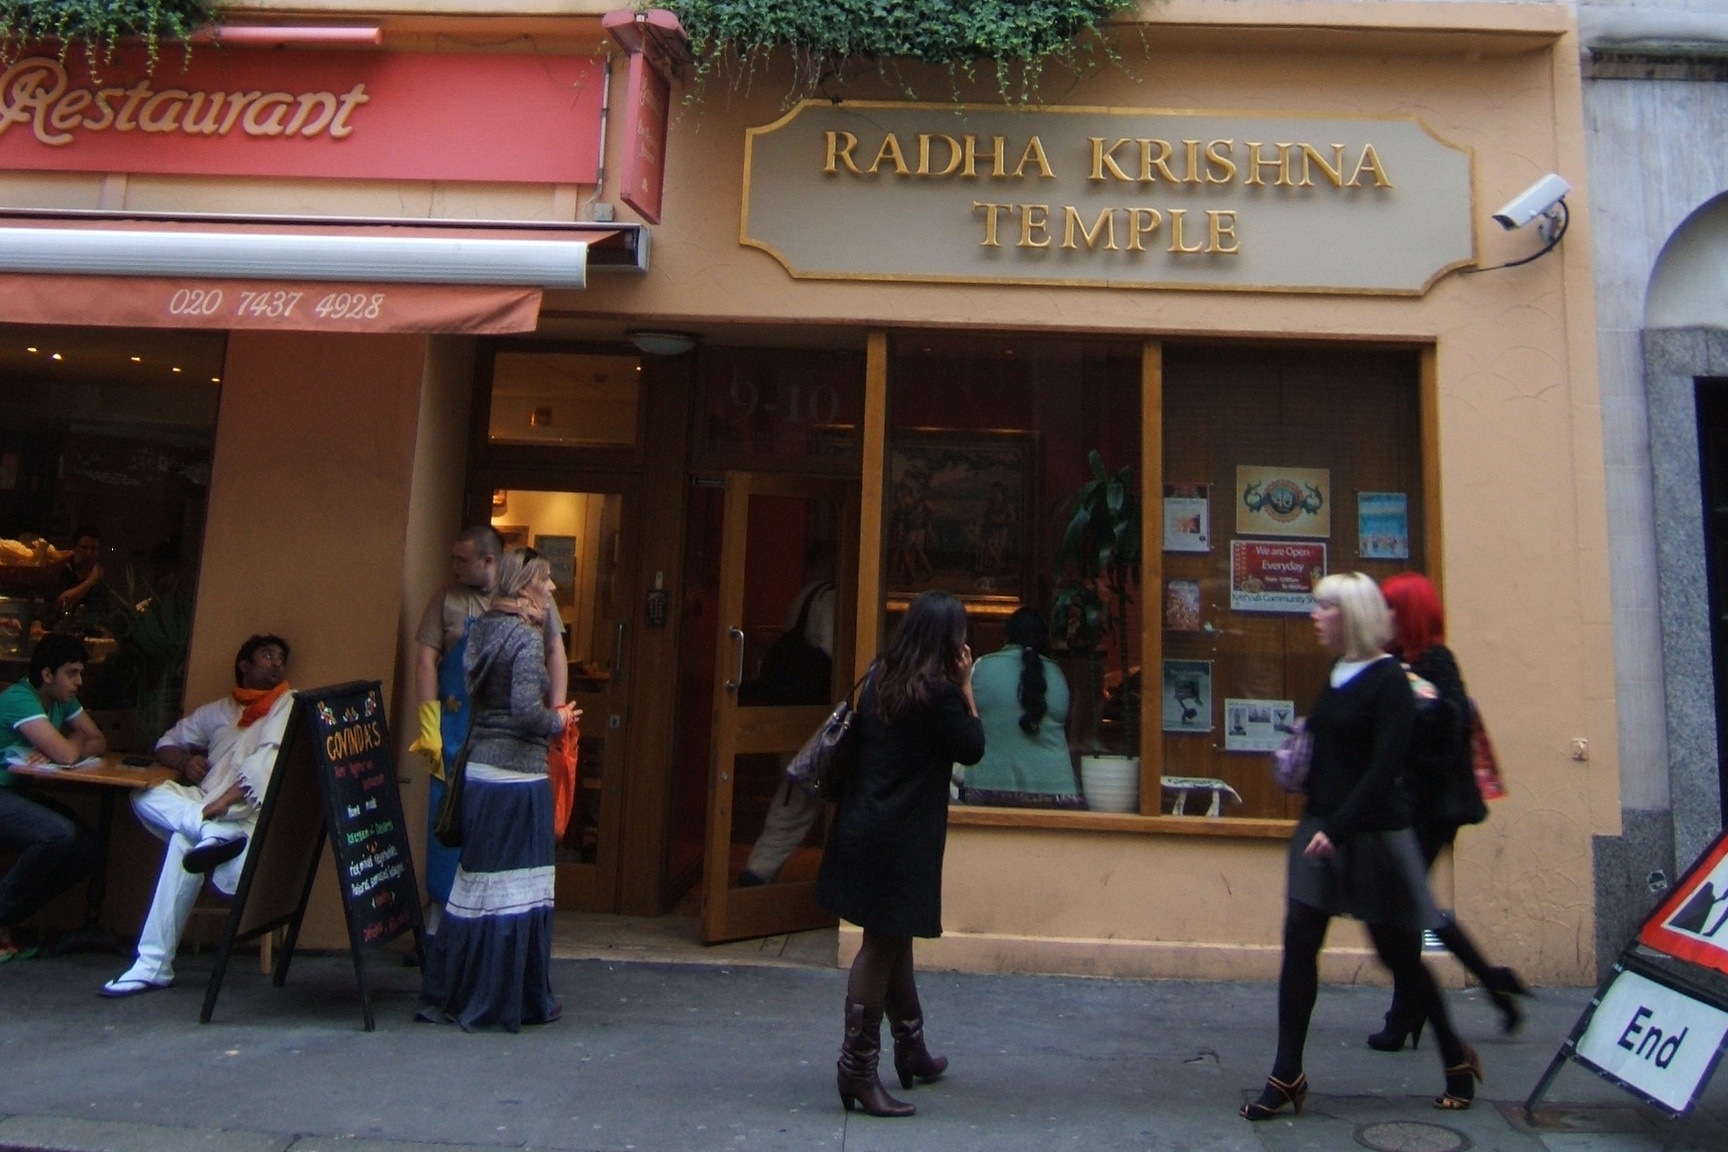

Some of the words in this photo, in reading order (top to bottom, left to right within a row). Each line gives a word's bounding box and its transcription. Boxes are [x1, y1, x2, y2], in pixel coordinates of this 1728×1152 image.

[0, 57, 369, 146] Restaurant
[822, 130, 1057, 180] RADHA
[1087, 135, 1394, 190] KRISHNA
[972, 200, 1242, 254] TEMPLE
[169, 289, 223, 316] 020
[237, 290, 301, 318] 7437
[314, 292, 386, 320] 4928
[1256, 546, 1270, 556] We
[1271, 548, 1284, 556] are
[1285, 546, 1310, 558] Open
[1262, 559, 1304, 573] Everyday
[326, 721, 381, 761] GOVINDA'S
[1617, 1006, 1688, 1069] End
